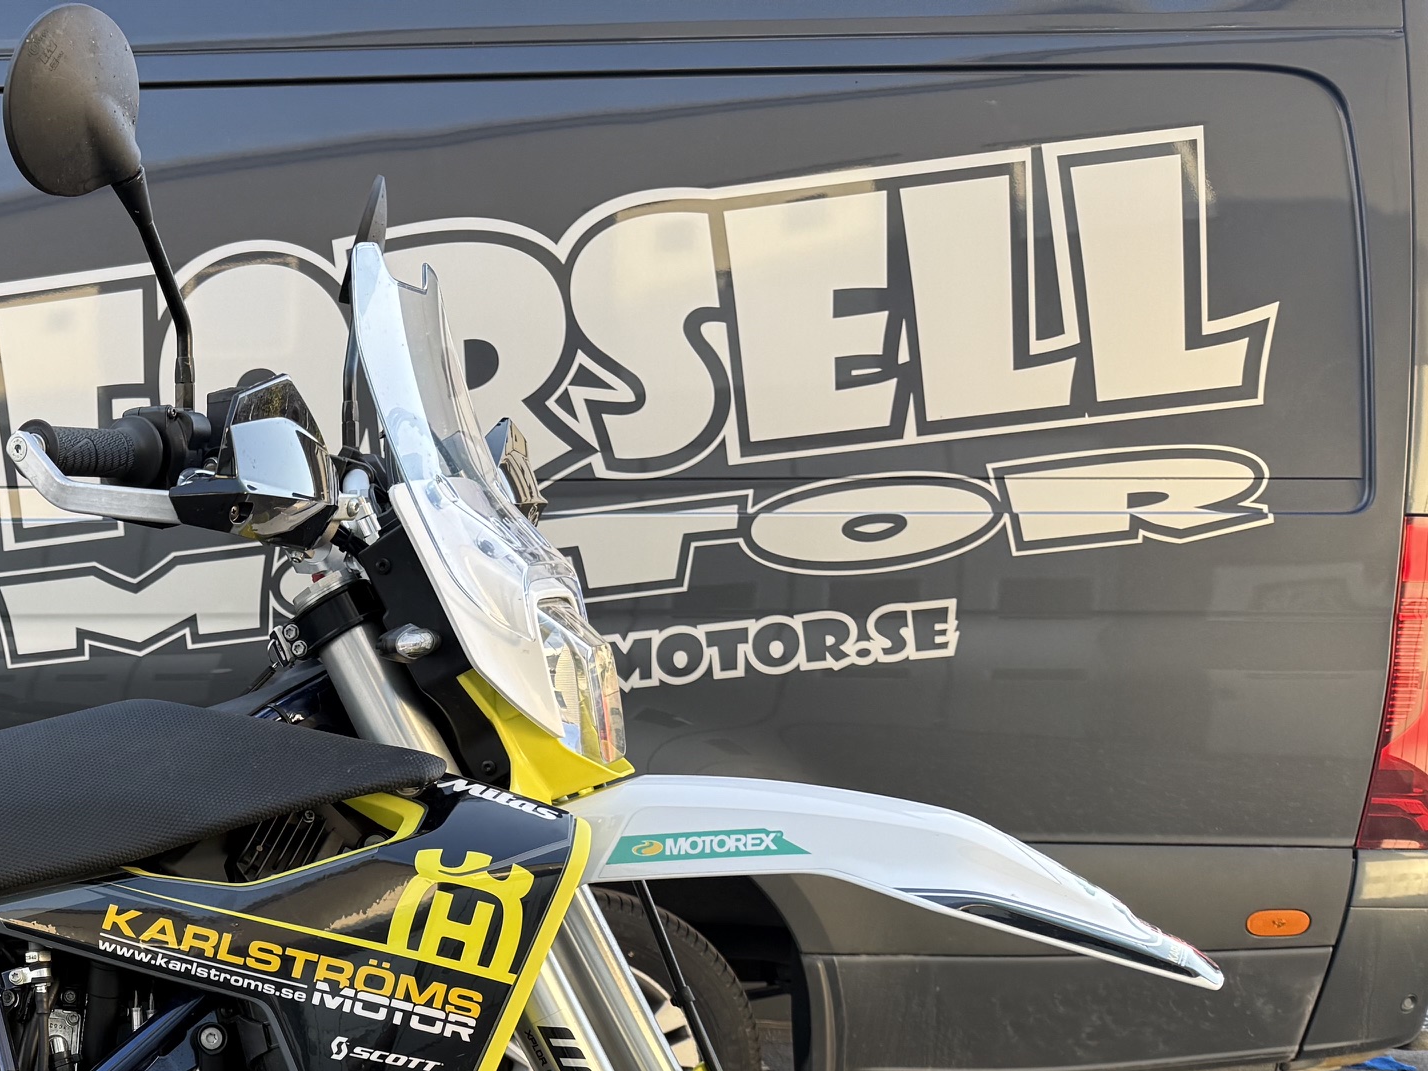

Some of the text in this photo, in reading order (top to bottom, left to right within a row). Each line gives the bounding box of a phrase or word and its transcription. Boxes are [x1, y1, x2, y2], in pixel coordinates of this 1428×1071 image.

[436, 778, 558, 821] Mitas
[665, 833, 778, 856] MOTOREX
[98, 939, 307, 1003] www.karlstroms.se
[101, 904, 484, 1019] KARLSTRÖMS
[311, 981, 476, 1042] MOTOR
[349, 1046, 441, 1071] SCOTT
